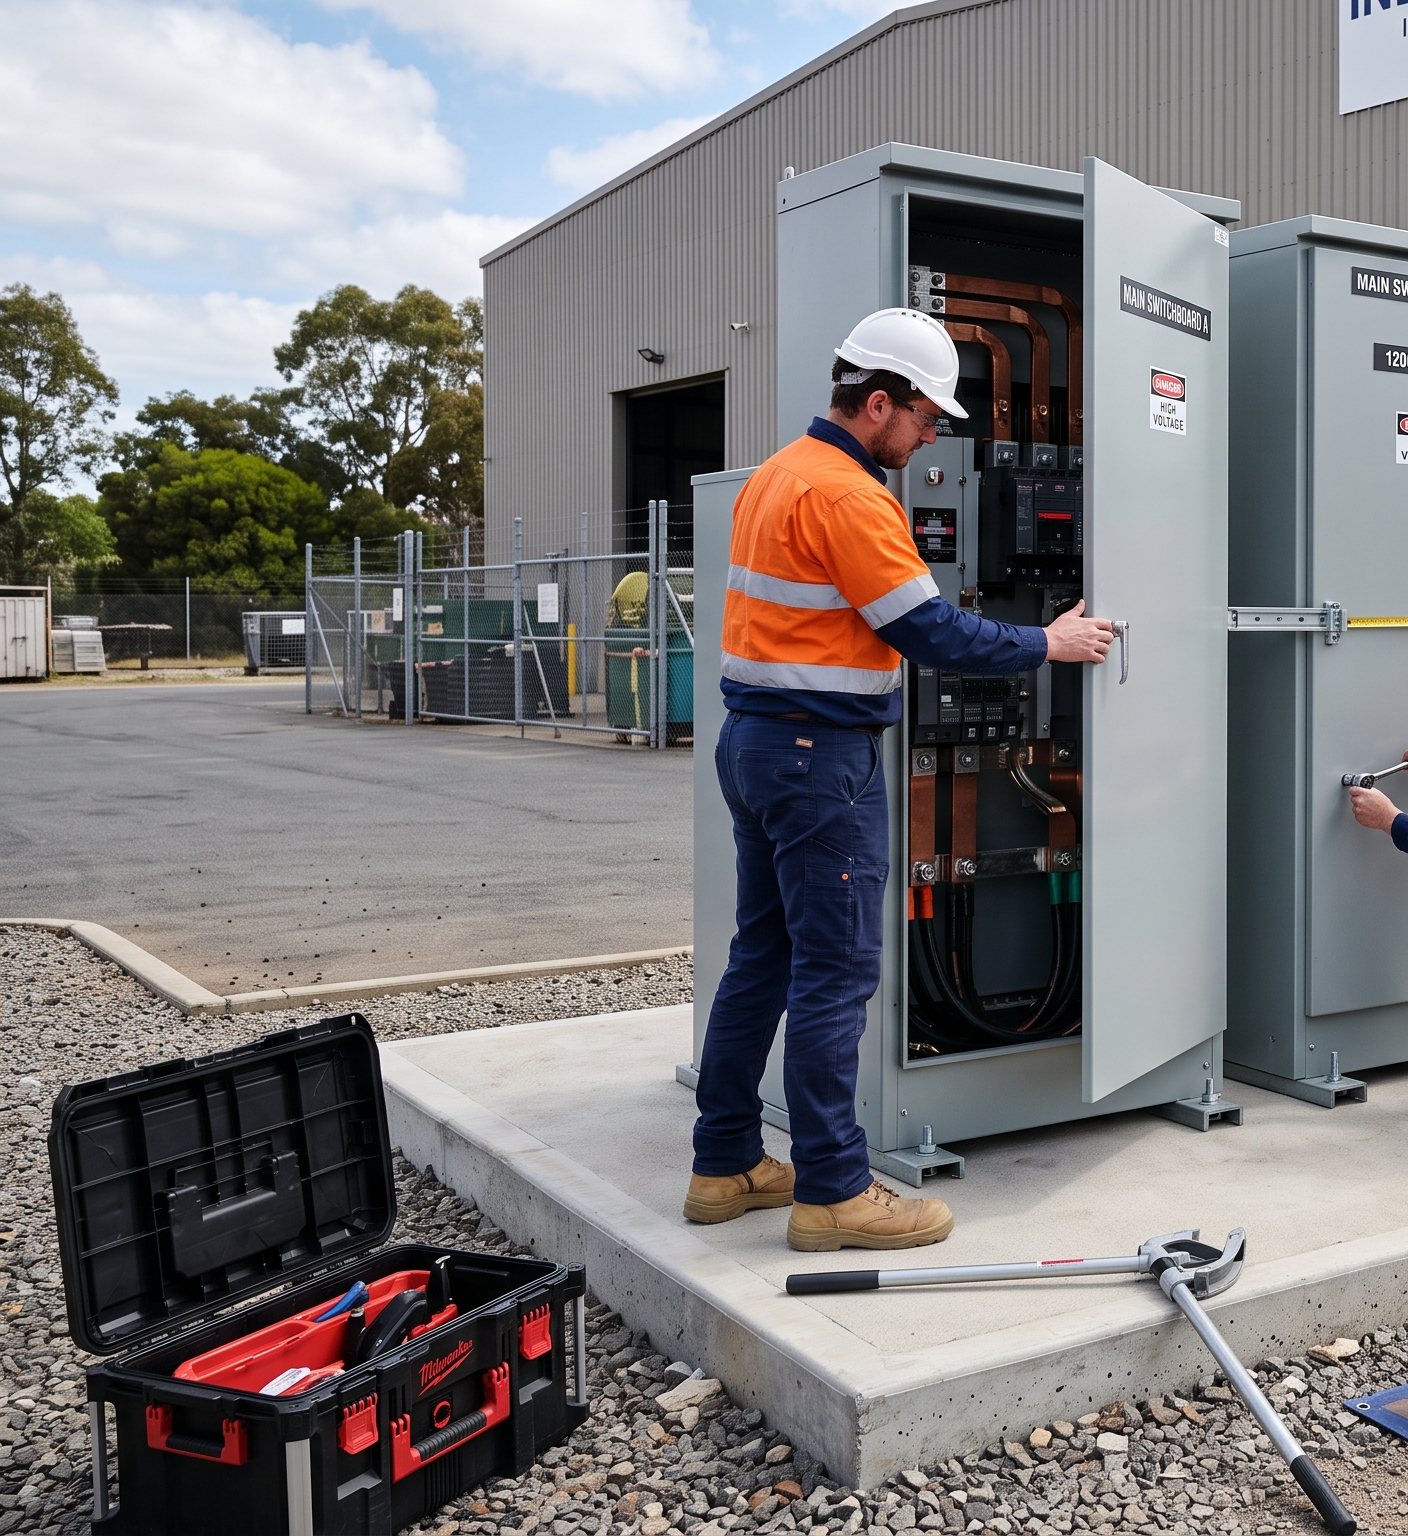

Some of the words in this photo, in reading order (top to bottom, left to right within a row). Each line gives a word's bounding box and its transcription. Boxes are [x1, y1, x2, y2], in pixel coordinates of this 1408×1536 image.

[1357, 272, 1390, 295] MAIN
[1123, 283, 1145, 311] MAIN
[1147, 292, 1202, 331] SWITCHBOARD
[1202, 314, 1209, 334] A
[1160, 401, 1176, 416] HIGH
[1153, 413, 1184, 431] VOLTAGE
